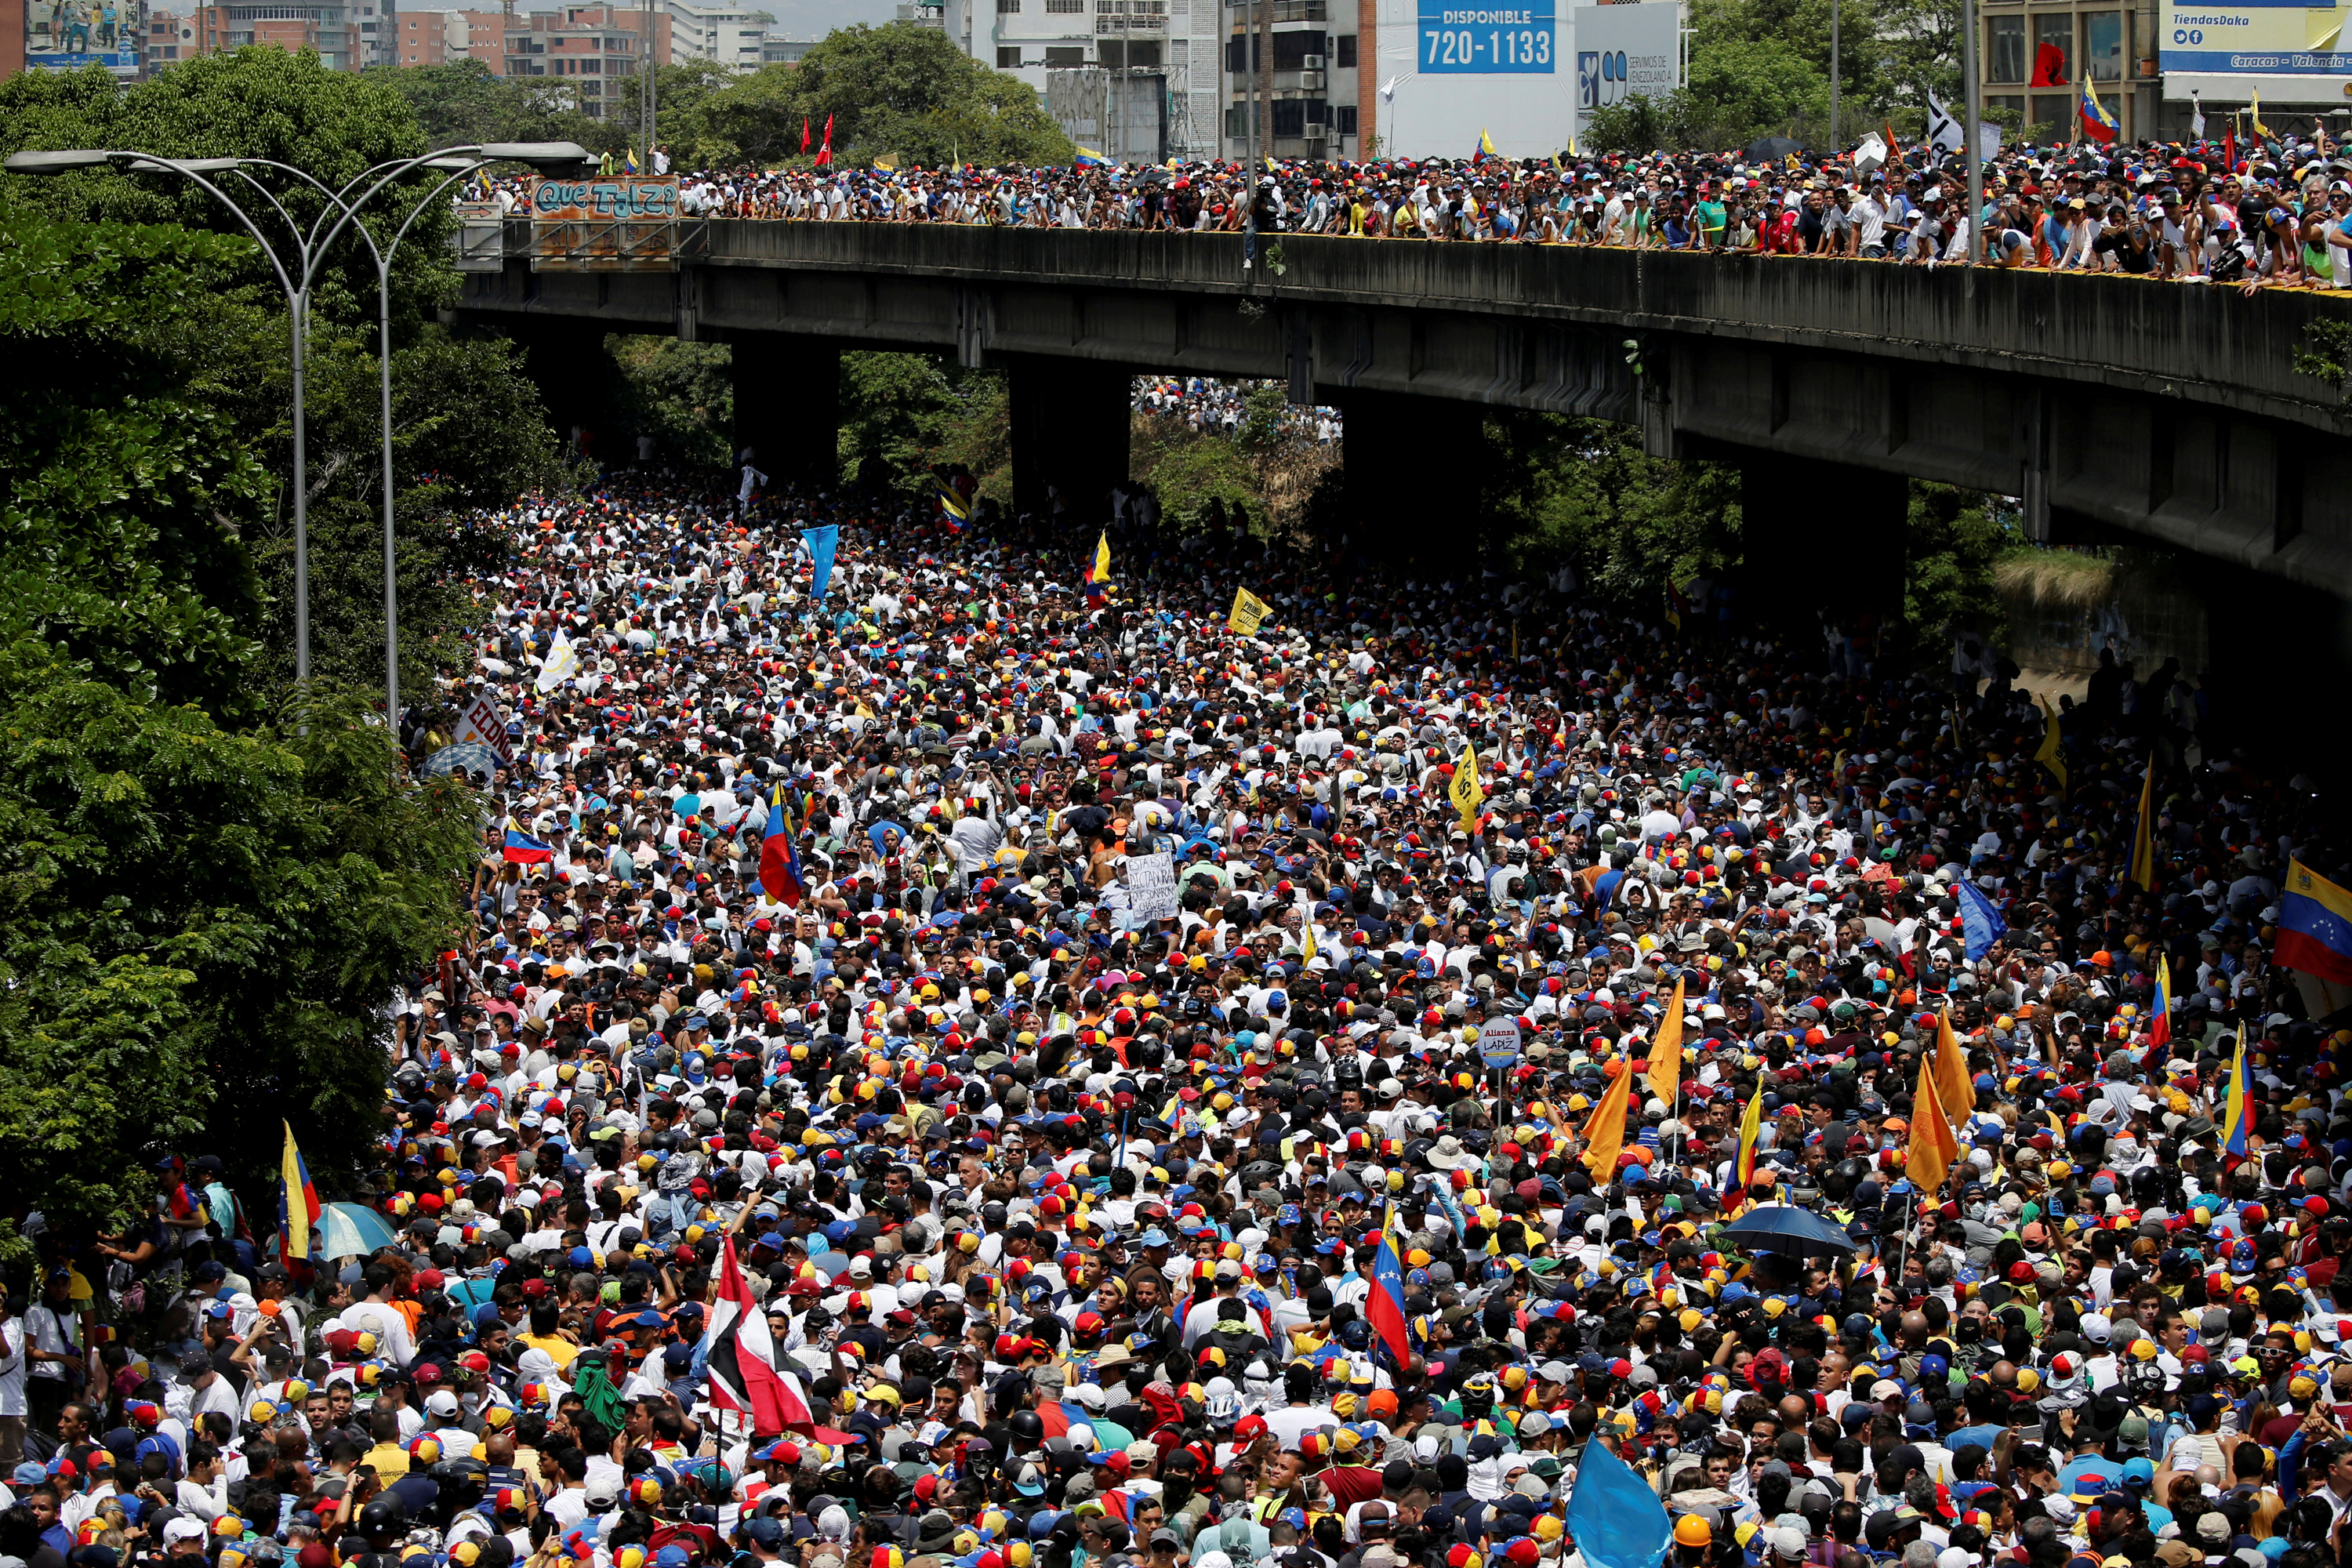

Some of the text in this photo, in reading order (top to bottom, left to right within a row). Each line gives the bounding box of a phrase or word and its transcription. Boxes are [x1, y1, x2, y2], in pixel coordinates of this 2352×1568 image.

[1443, 10, 1531, 24] DISPONIBLE
[2172, 13, 2250, 26] TiendasDaka
[1425, 31, 1550, 64] 720-1133
[1628, 55, 1667, 68] SERVIMOS DE
[2230, 56, 2279, 67] Caracas
[2292, 54, 2345, 68] Valencia
[1628, 70, 1672, 83] VENEZOLANO A
[1128, 855, 1171, 871] ESTA ES LA
[1130, 869, 1174, 890] DICTADURA
[1132, 886, 1174, 902] QUE SOÑARON
[1139, 898, 1174, 912] CHÁVEZ Y
[1144, 909, 1169, 921] FIDEL
[1484, 1029, 1515, 1037] Alianza
[1483, 1037, 1515, 1051] LÁPIZ
